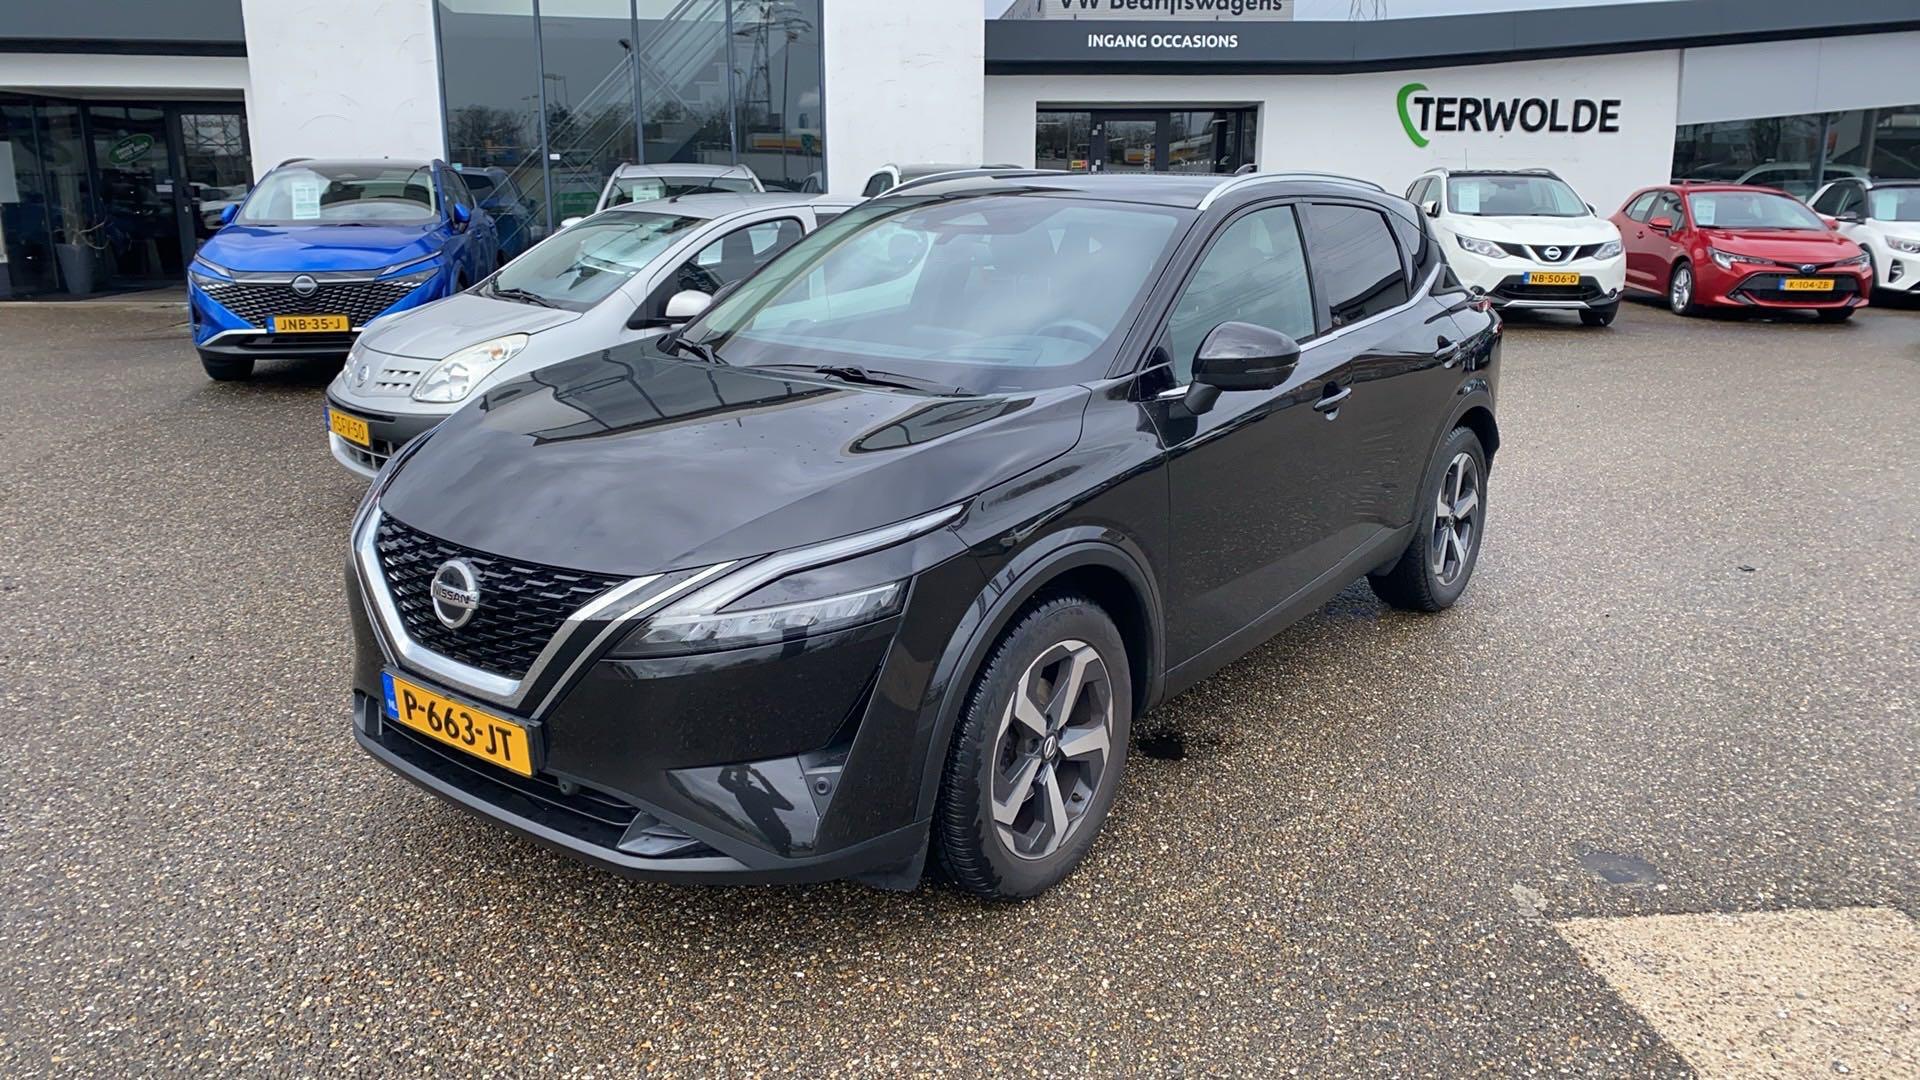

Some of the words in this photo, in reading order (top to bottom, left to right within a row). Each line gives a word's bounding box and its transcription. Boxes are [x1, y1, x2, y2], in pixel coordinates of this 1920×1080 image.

[1061, 0, 1098, 9] VW
[1087, 34, 1147, 48] INGANG
[1151, 34, 1239, 49] OCCASIONS
[1413, 97, 1622, 133] TERWOLDE
[1531, 274, 1577, 284] NB-506-D
[281, 317, 341, 331] JNB-35-J
[433, 583, 470, 604] NISSAN
[403, 689, 512, 761] P-663-JT
